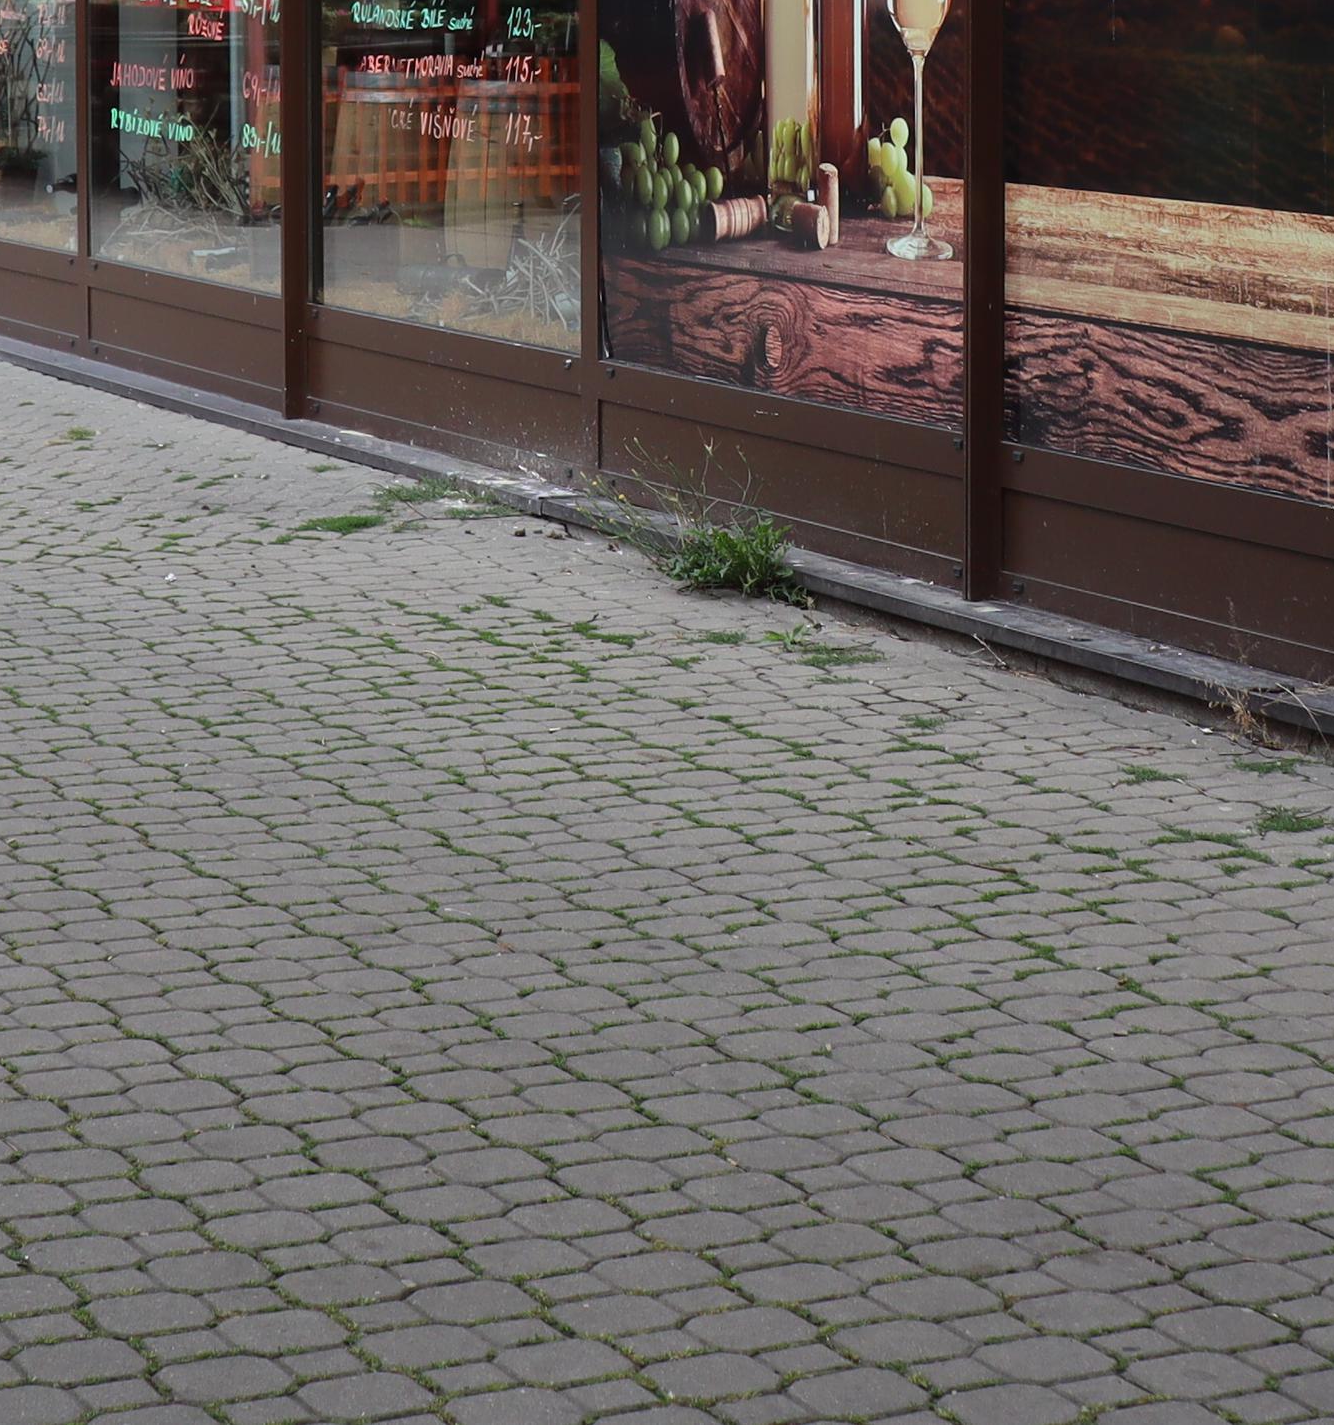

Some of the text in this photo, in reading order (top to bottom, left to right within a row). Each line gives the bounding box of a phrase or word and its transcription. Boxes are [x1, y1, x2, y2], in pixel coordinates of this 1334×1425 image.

[506, 5, 543, 40] 123,-
[109, 54, 167, 91] JAHODOVÉ
[505, 55, 542, 85] 115,-
[110, 107, 164, 139] RYBÍZOVÉ
[420, 103, 477, 143] VIŠŇOVÉ
[505, 111, 543, 153] 117,-
